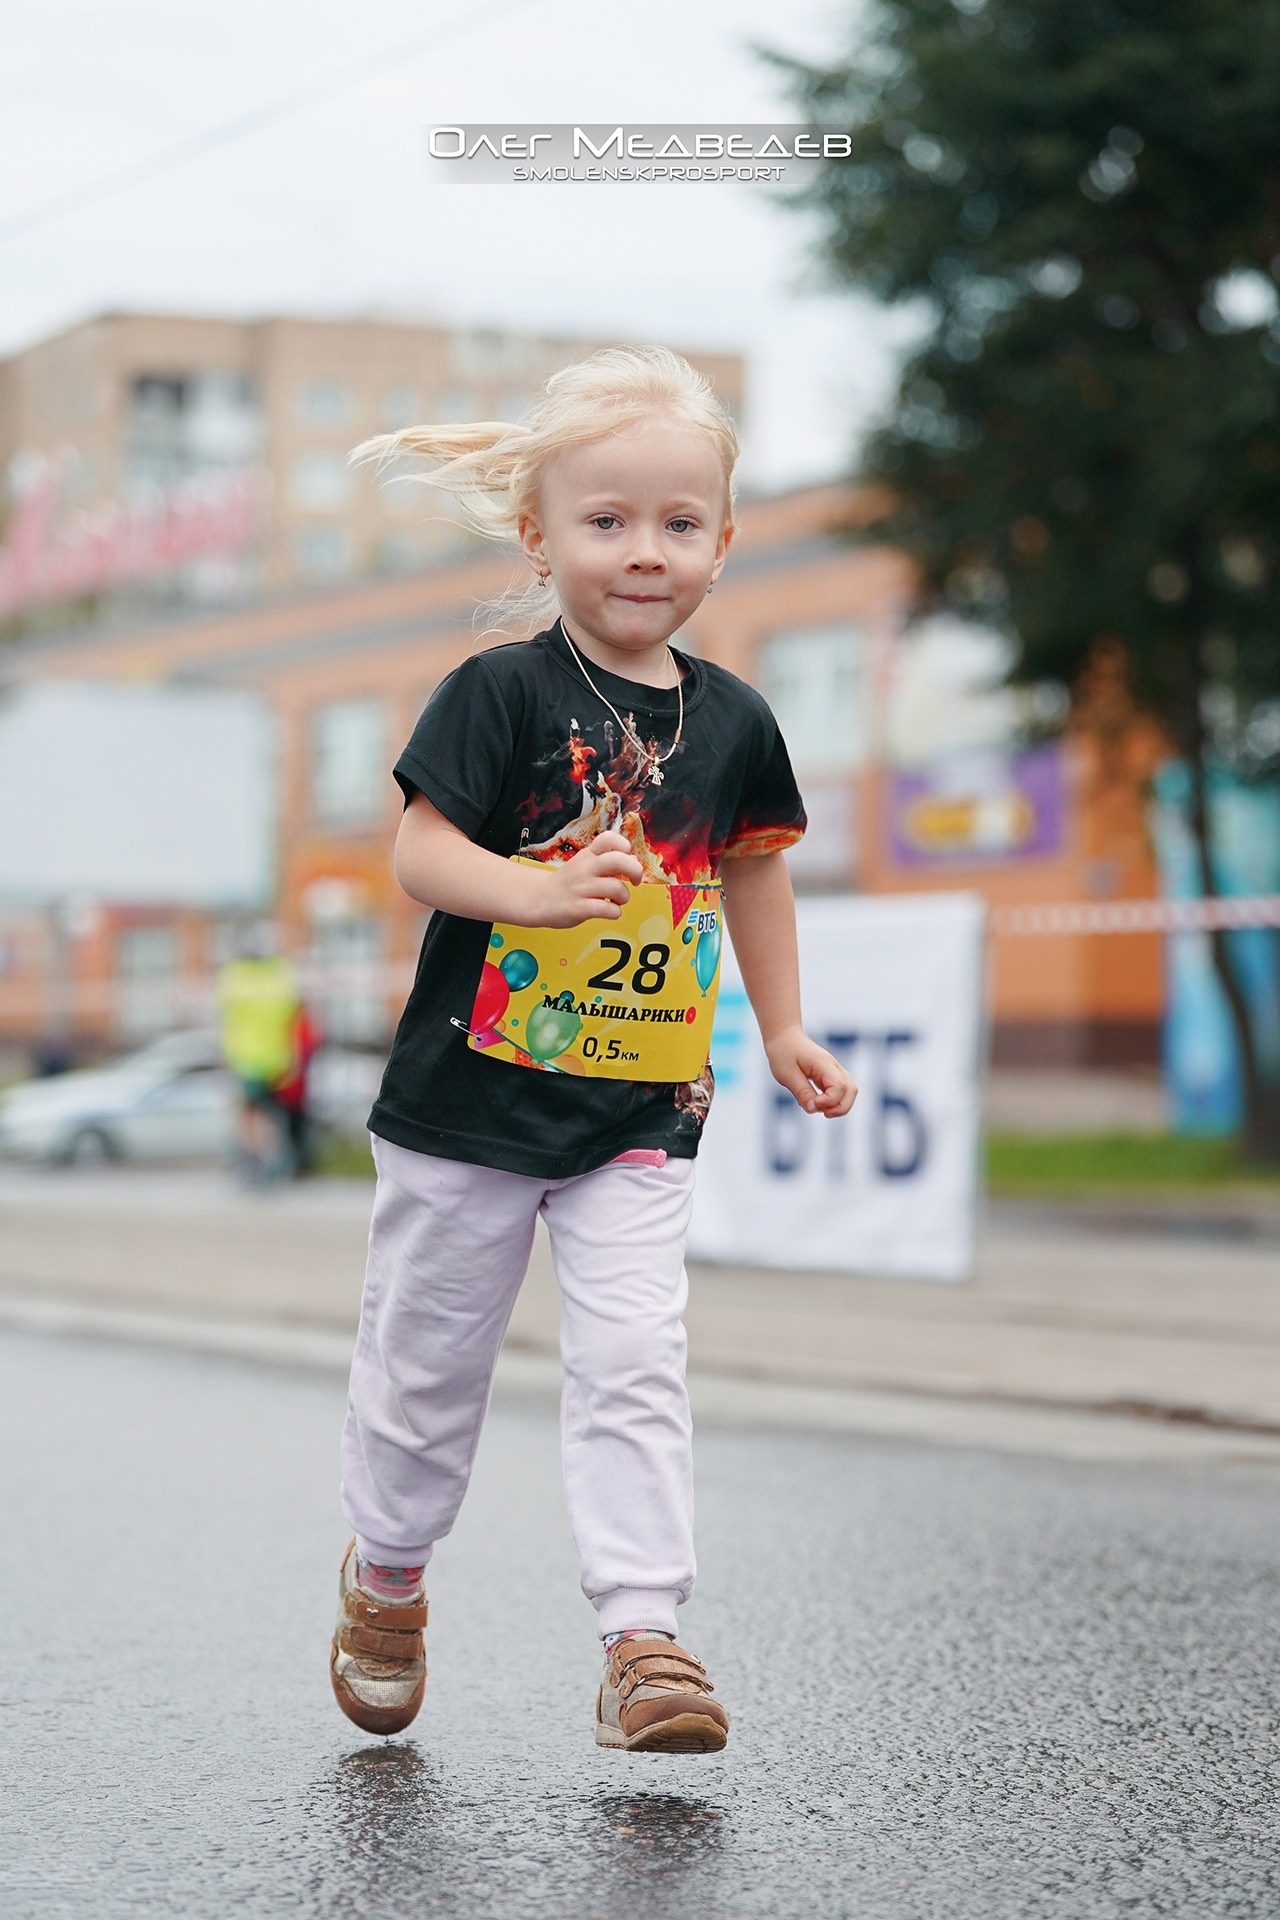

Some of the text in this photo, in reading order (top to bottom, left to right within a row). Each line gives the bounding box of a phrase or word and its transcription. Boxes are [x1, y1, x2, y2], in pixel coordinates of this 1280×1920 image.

[697, 911, 716, 932] ВТБ
[587, 939, 670, 994] 28
[543, 995, 684, 1023] МАЛЫШАРИКИ
